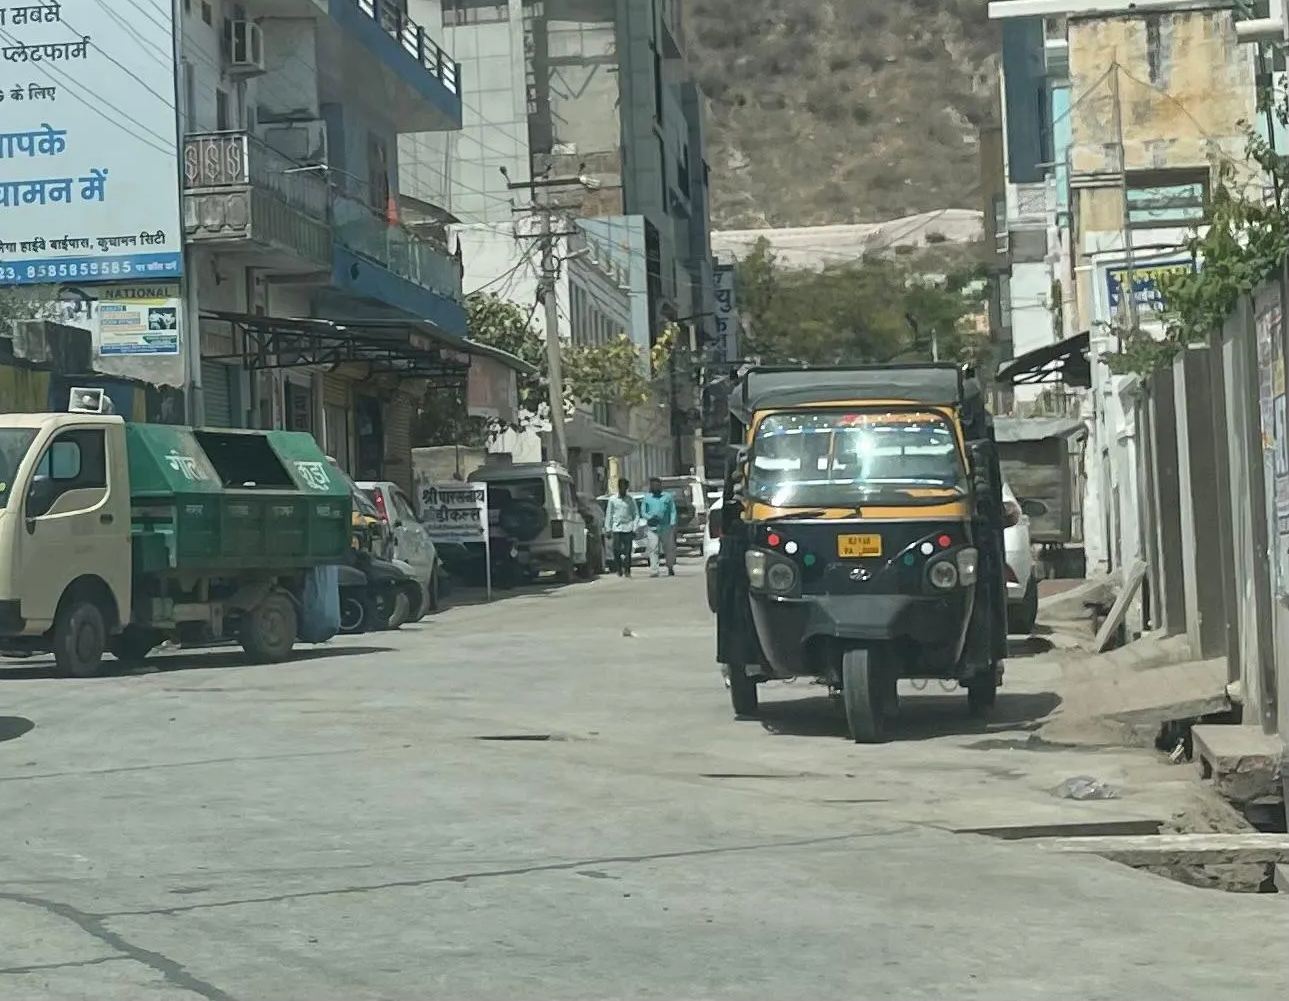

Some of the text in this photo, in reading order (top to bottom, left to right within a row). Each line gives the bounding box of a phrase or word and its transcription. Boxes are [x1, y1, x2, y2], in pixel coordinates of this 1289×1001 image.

[10, 0, 62, 23] सबसे
[1, 36, 91, 64] प्लेटफार्म
[10, 83, 25, 102] के
[29, 84, 57, 102] लिए
[78, 168, 109, 203] में
[140, 229, 166, 246] सिटी
[105, 287, 172, 299] NATIONAL
